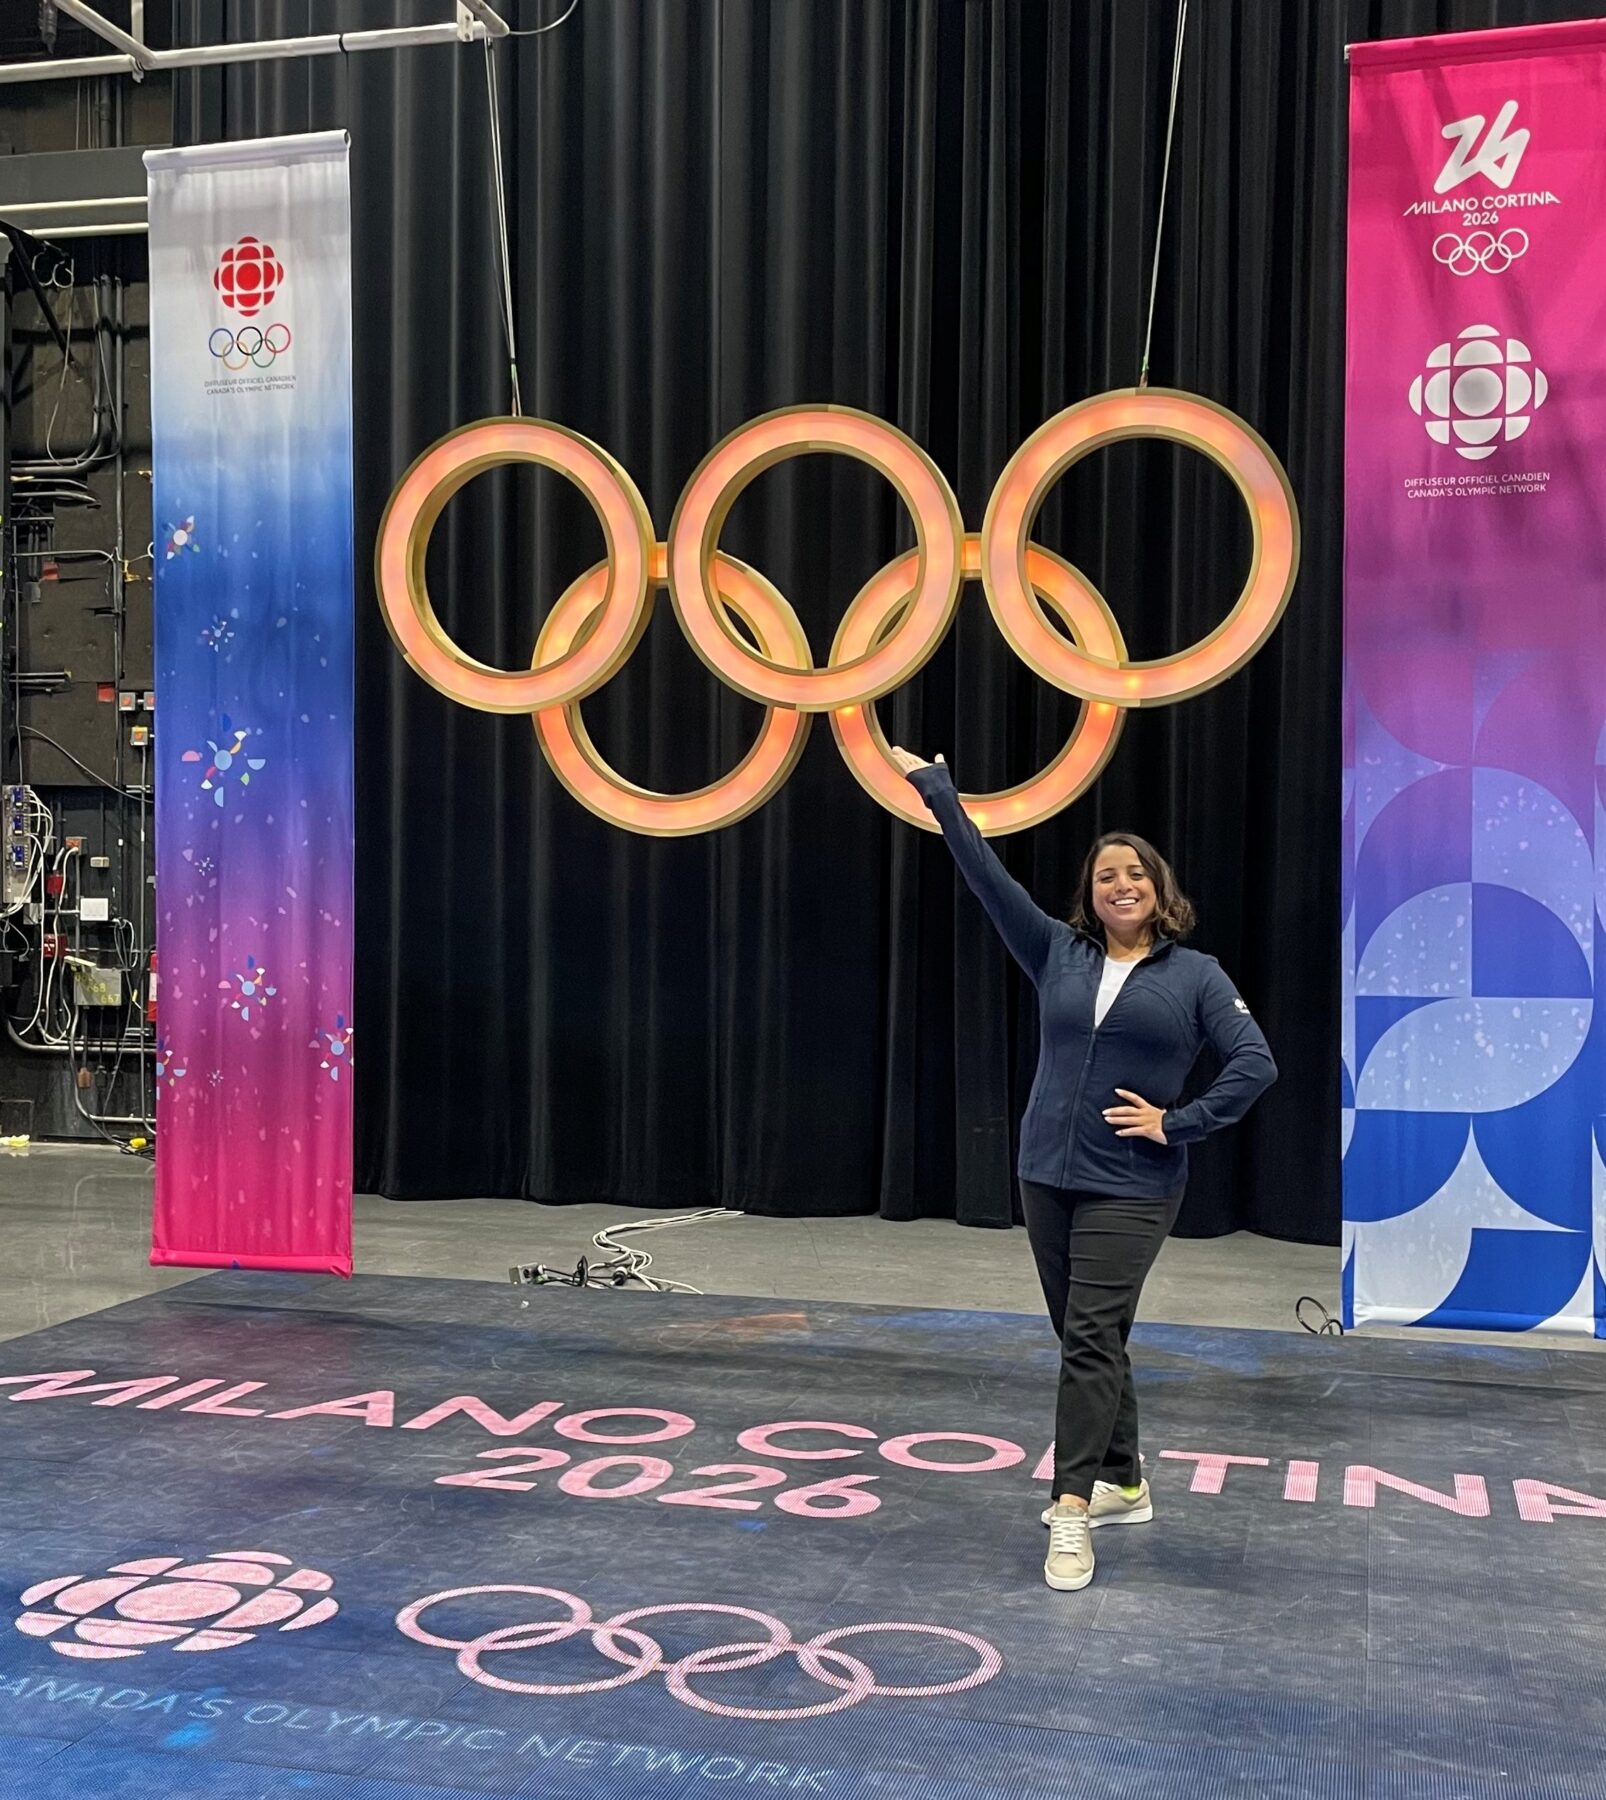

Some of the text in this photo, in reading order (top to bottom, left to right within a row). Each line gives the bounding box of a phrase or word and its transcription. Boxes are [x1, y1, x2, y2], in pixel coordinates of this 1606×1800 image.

[1402, 191, 1561, 216] MILANO CORTINA
[1462, 211, 1499, 226] 2026
[1404, 472, 1550, 488] DIFFUSEUR OFFICIEL CANADIEN
[1407, 483, 1547, 499] CANADA'S OLYMPIC NETWORK
[0, 1369, 1606, 1523] MILANO COTINA
[434, 1446, 882, 1518] 2026
[0, 1675, 835, 1793] ANADA'S OLYMPIC NETWORK
